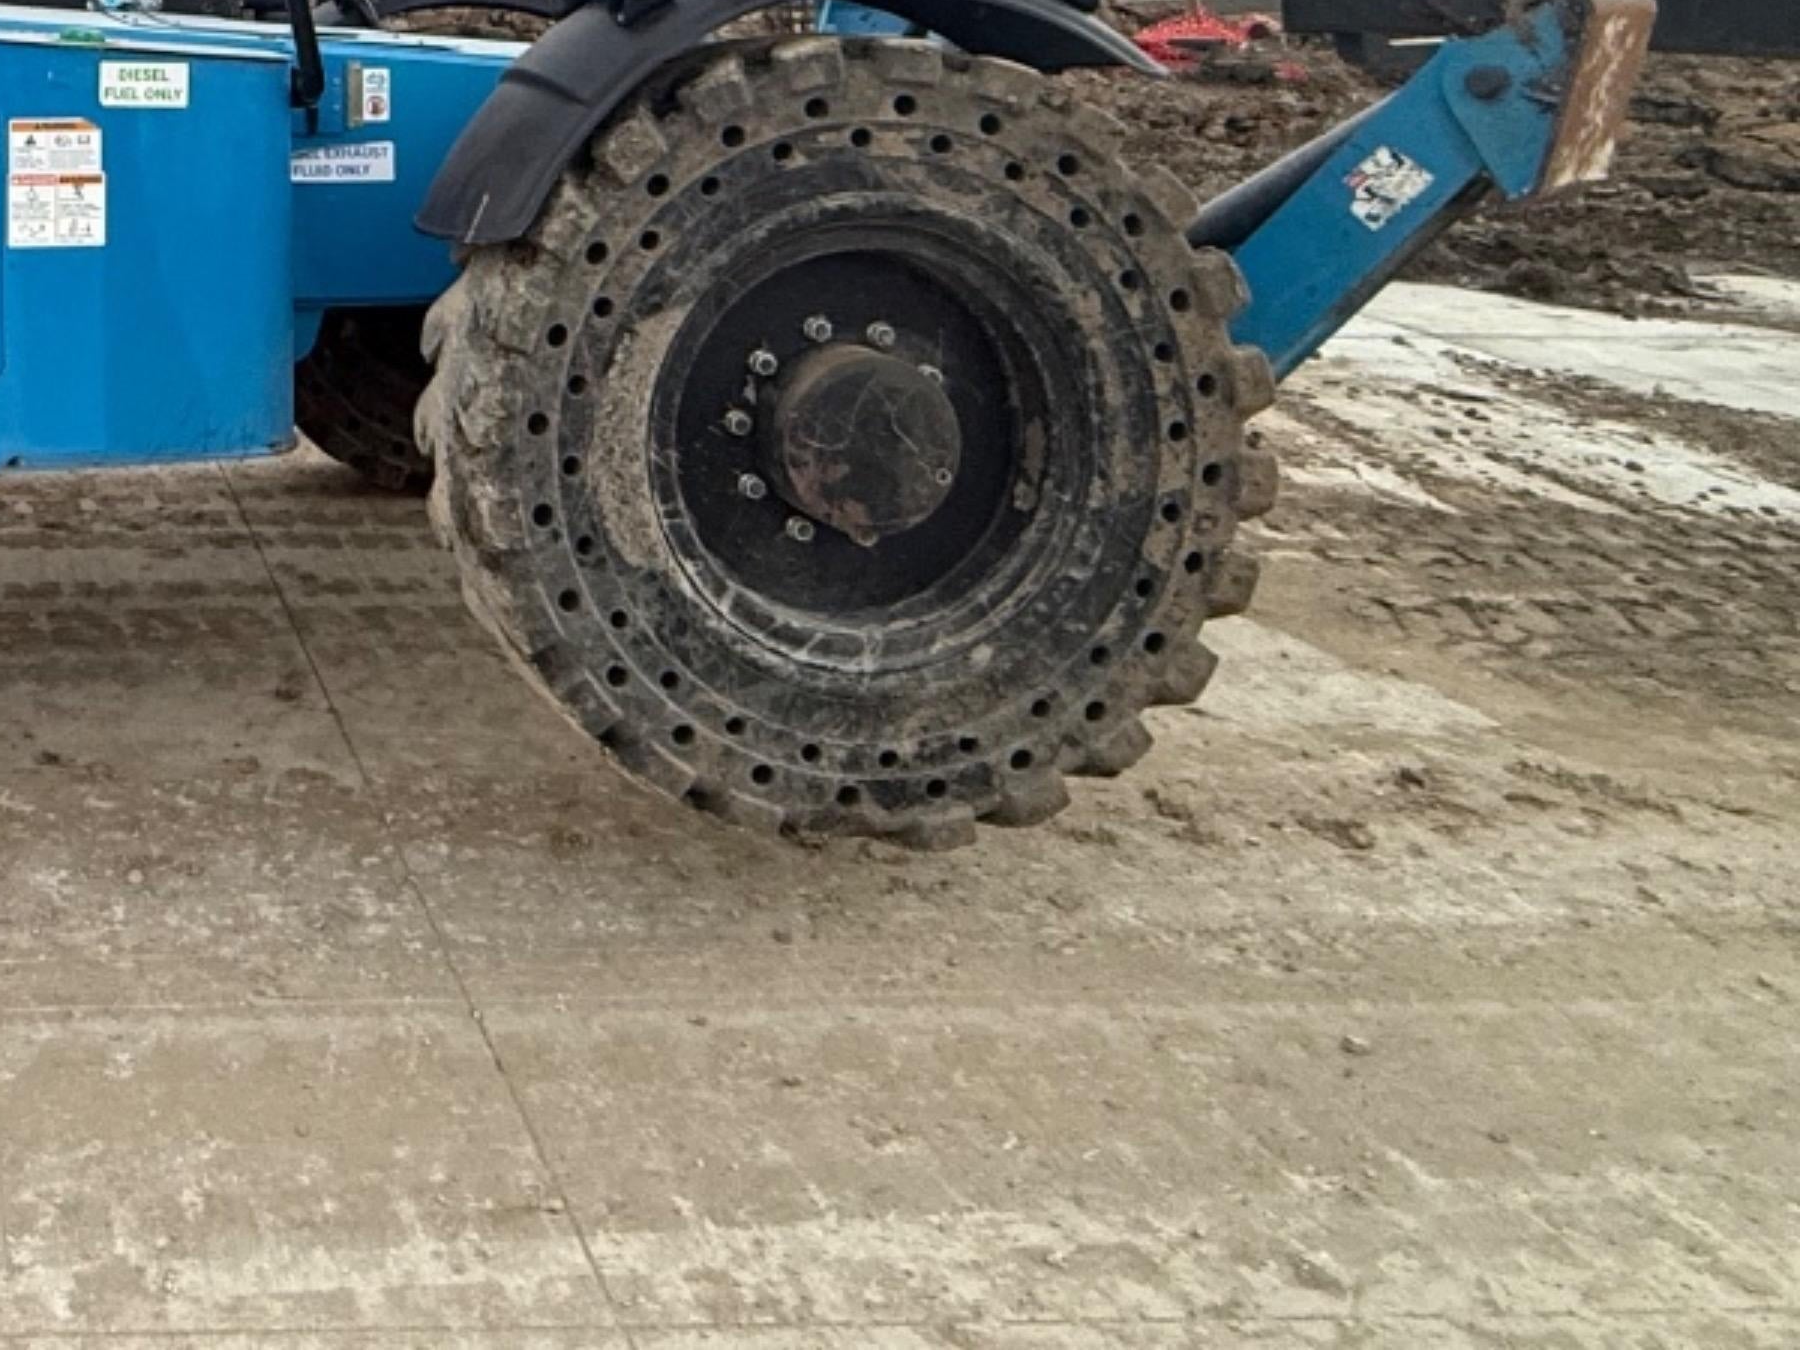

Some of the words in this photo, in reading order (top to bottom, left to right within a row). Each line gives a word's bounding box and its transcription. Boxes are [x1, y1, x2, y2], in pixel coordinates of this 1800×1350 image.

[118, 66, 170, 82] DIESEL
[104, 86, 139, 101] FUEL
[143, 86, 184, 101] ONLY
[293, 163, 332, 178] FLUID
[335, 163, 371, 178] ONLY
